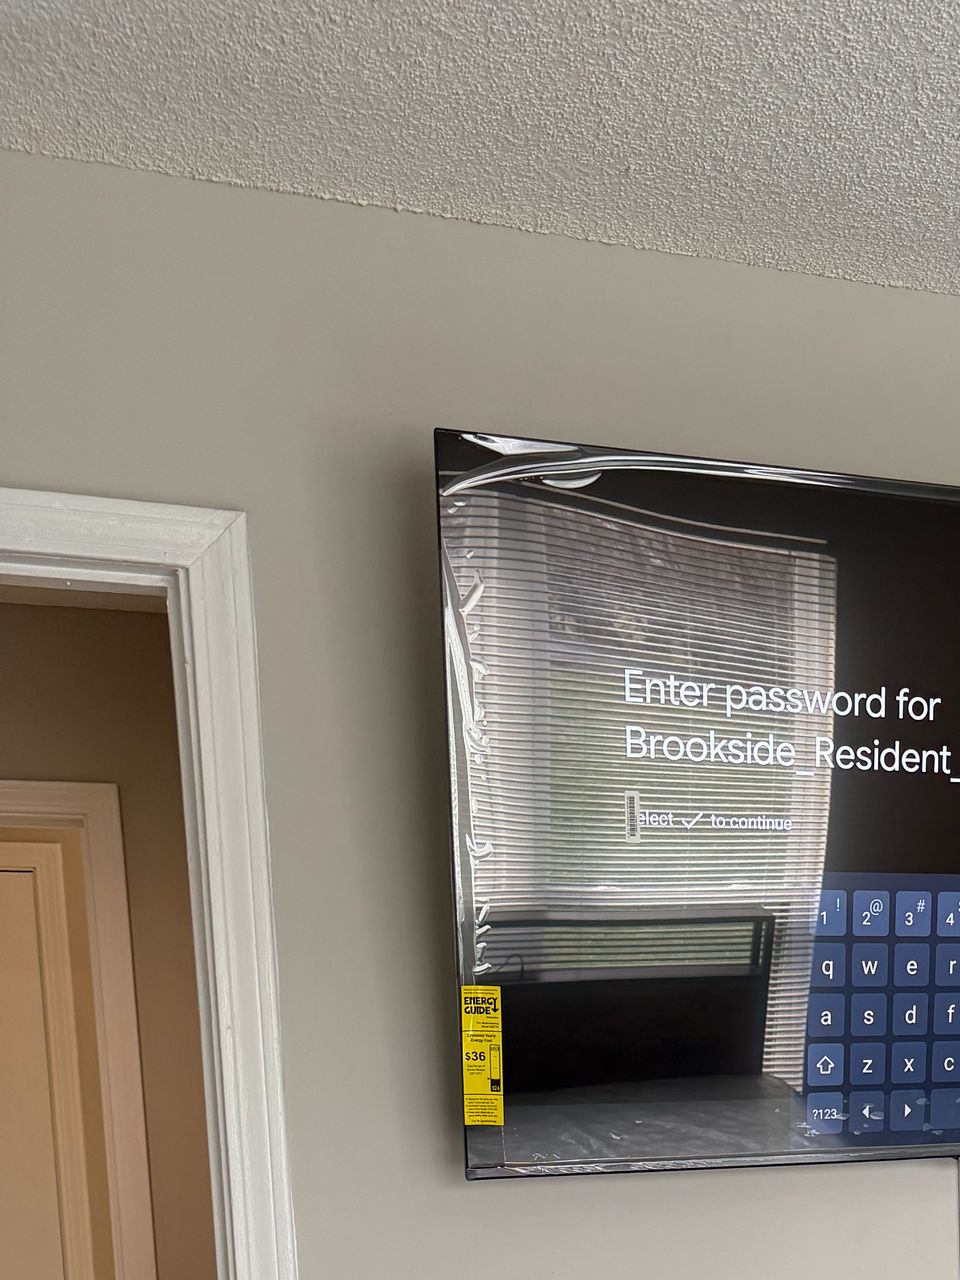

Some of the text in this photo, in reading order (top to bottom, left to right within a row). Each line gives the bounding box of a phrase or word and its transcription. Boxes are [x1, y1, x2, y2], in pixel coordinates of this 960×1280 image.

[624, 668, 942, 721] Enter password for
[637, 810, 793, 831] elect to continue
[820, 911, 828, 925] 1
[862, 912, 871, 926] 2
[905, 912, 914, 926] 3
[946, 913, 955, 926] 4
[821, 960, 834, 980] q
[862, 960, 878, 975] w
[906, 960, 918, 975] e
[949, 959, 957, 975] r
[464, 996, 498, 1006] ENERGY
[464, 1006, 491, 1015] GUIDE
[820, 1010, 832, 1025] a
[863, 1010, 874, 1025] s
[905, 1005, 917, 1024] d
[947, 1004, 956, 1023] f
[465, 1051, 486, 1062] $36
[862, 1059, 873, 1073] z
[904, 1058, 914, 1072] x
[944, 1057, 955, 1071] c
[812, 1108, 837, 1120] ?123
